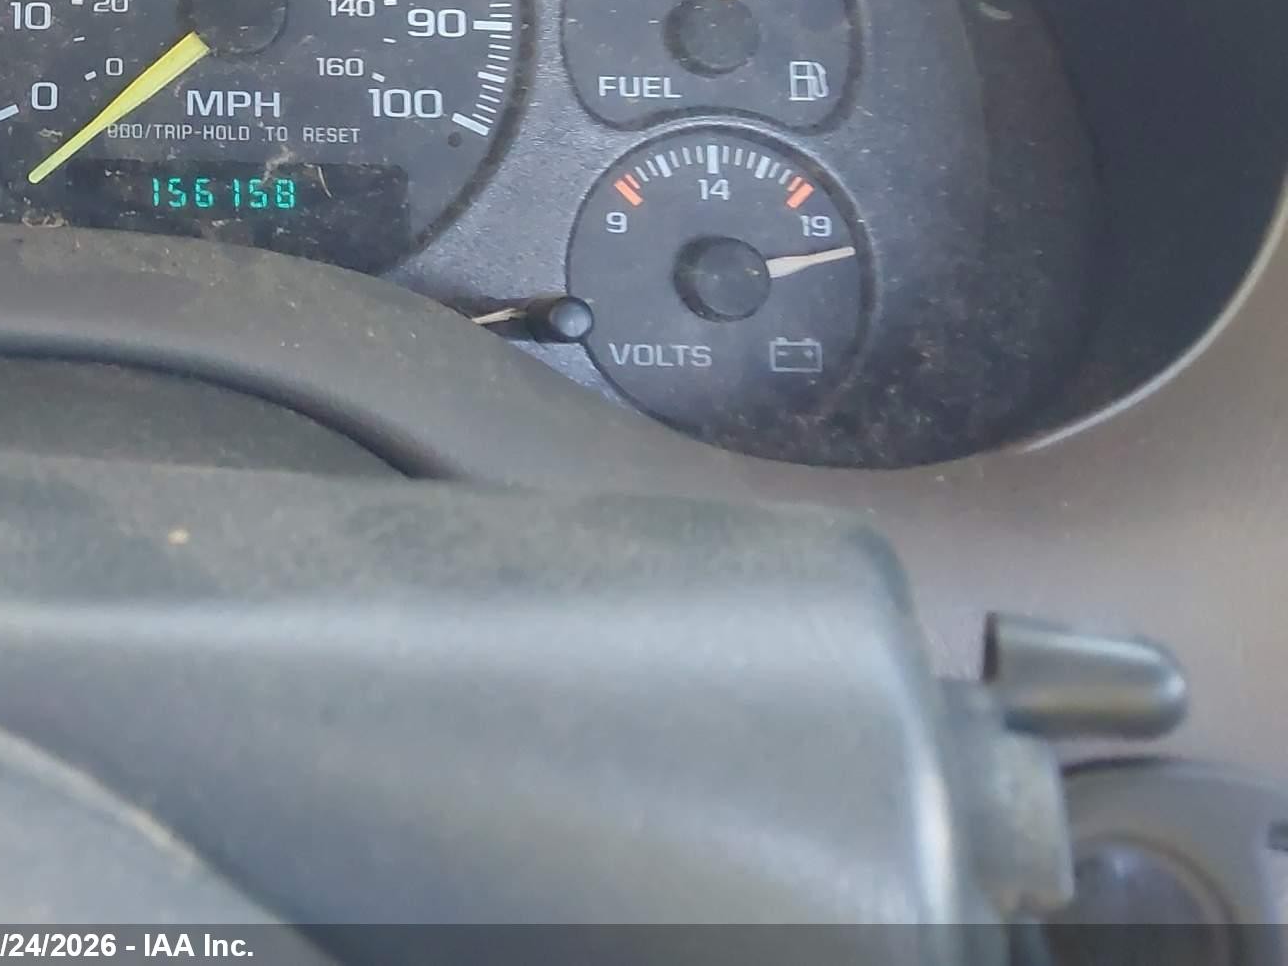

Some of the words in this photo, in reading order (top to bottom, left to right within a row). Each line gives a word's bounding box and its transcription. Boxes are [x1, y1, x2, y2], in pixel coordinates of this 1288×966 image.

[10, 2, 52, 30] 10
[407, 9, 467, 38] 90
[105, 57, 124, 76] 0
[316, 57, 364, 76] 160
[31, 82, 58, 110] 0
[598, 76, 682, 98] FUEL
[187, 91, 281, 117] MPH
[368, 89, 443, 119] 100
[266, 126, 288, 142] TO
[303, 127, 361, 143] RESET
[152, 177, 296, 209] 156158
[697, 179, 729, 200] 14
[605, 212, 628, 233] 9
[800, 215, 832, 236] 19
[609, 343, 712, 367] VOLTS
